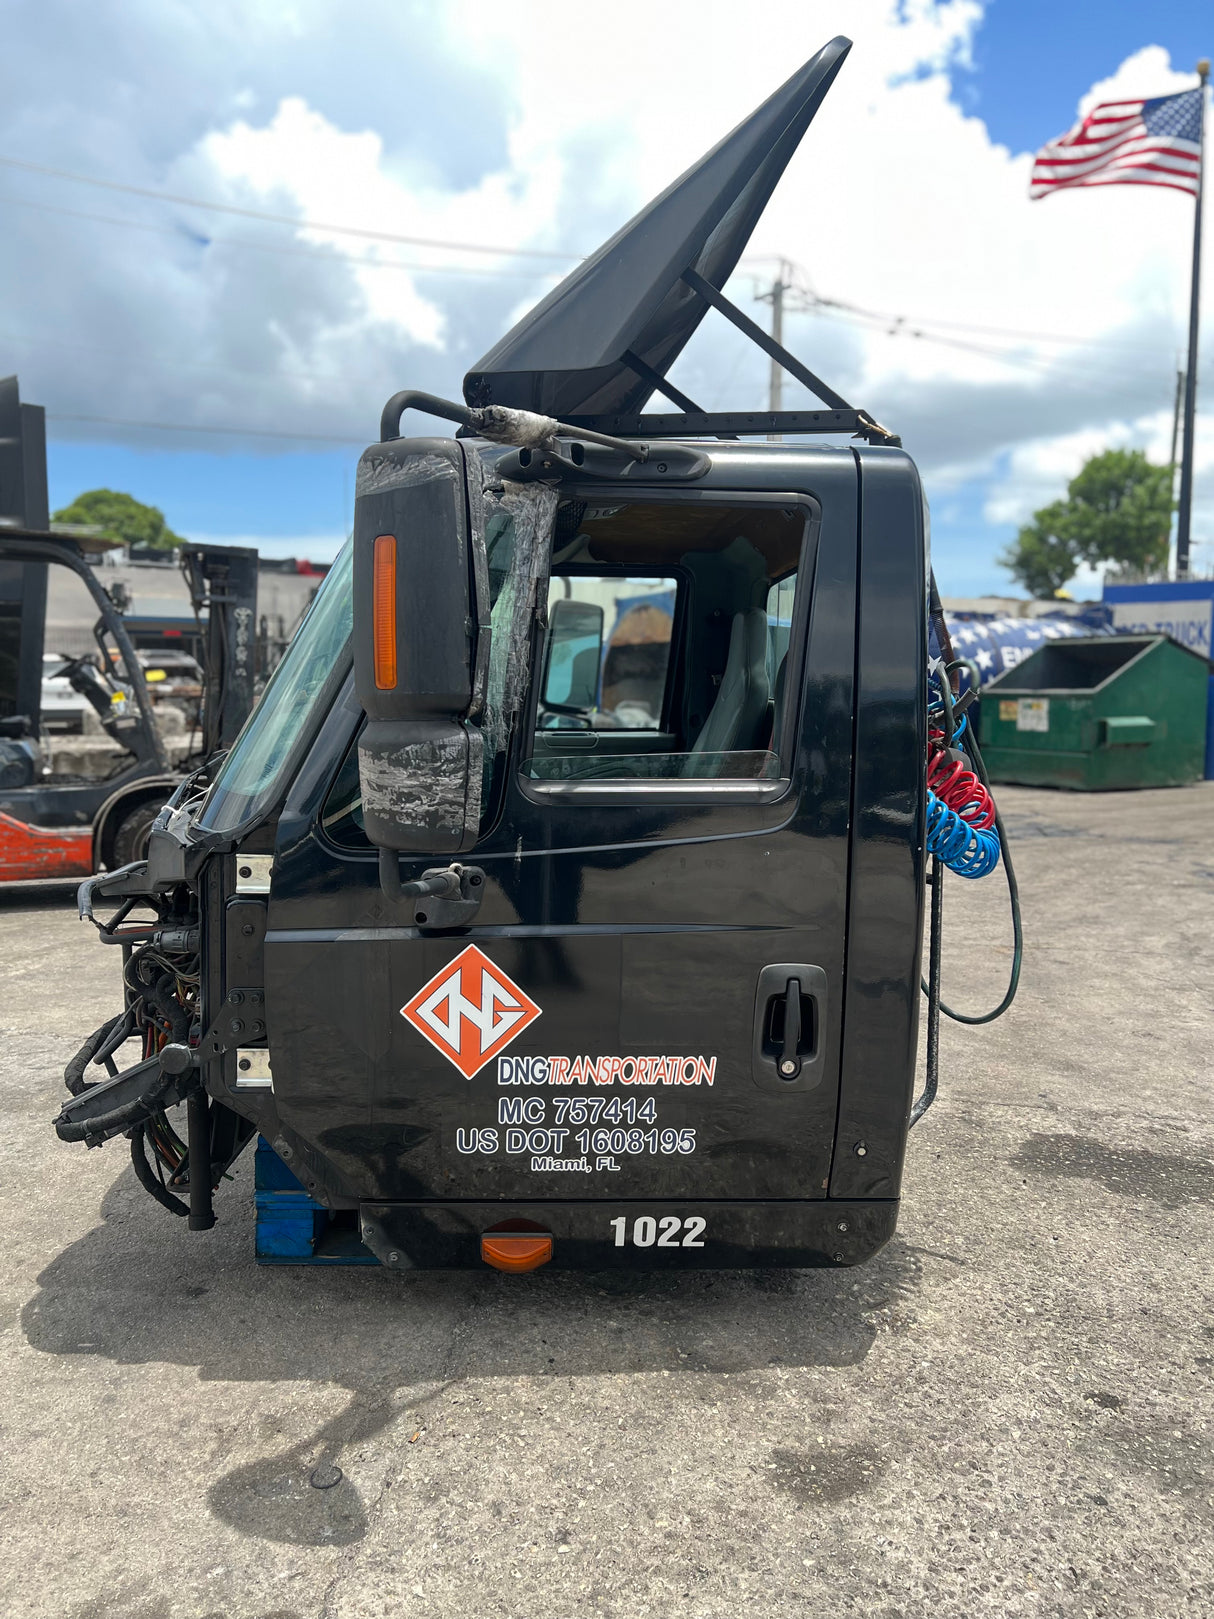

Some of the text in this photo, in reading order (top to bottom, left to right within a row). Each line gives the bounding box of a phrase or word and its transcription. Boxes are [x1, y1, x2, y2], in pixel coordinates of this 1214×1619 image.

[498, 1097, 657, 1124] MC 757414
[456, 1128, 696, 1154] US DOT 1608195
[530, 1156, 621, 1173] Miami, FL
[609, 1216, 707, 1247] 1022
